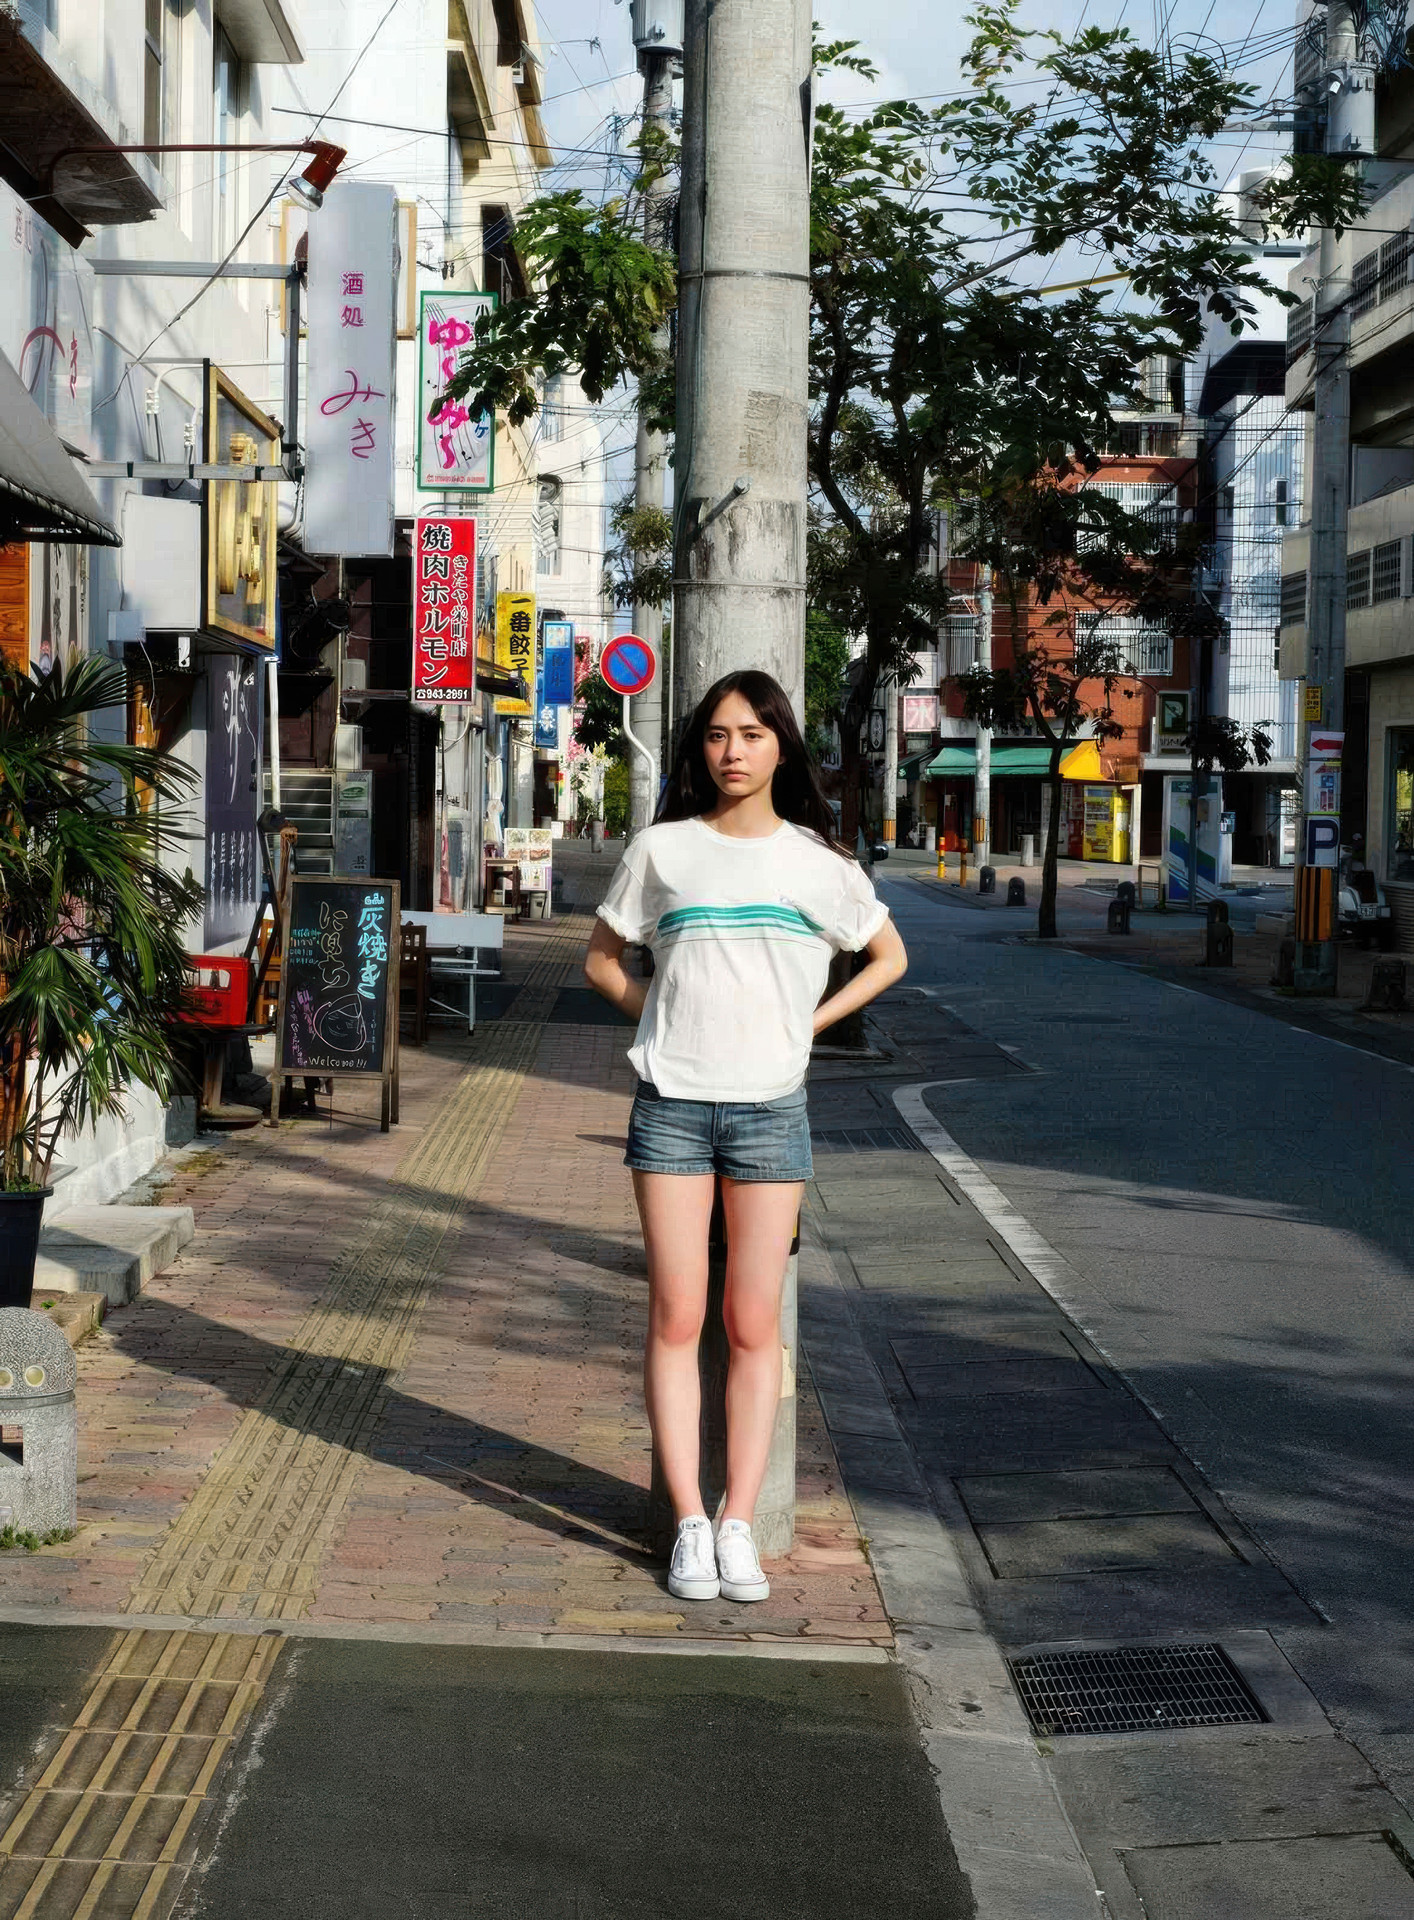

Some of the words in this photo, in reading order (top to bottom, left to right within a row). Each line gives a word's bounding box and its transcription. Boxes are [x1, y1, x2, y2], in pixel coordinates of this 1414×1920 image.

[341, 272, 365, 328] 酒処
[320, 369, 387, 459] みき
[420, 523, 452, 685] 焼肉ホルモン
[509, 597, 532, 681] 一番餃子
[1308, 819, 1338, 865] P
[357, 892, 388, 1000] 炭焼き
